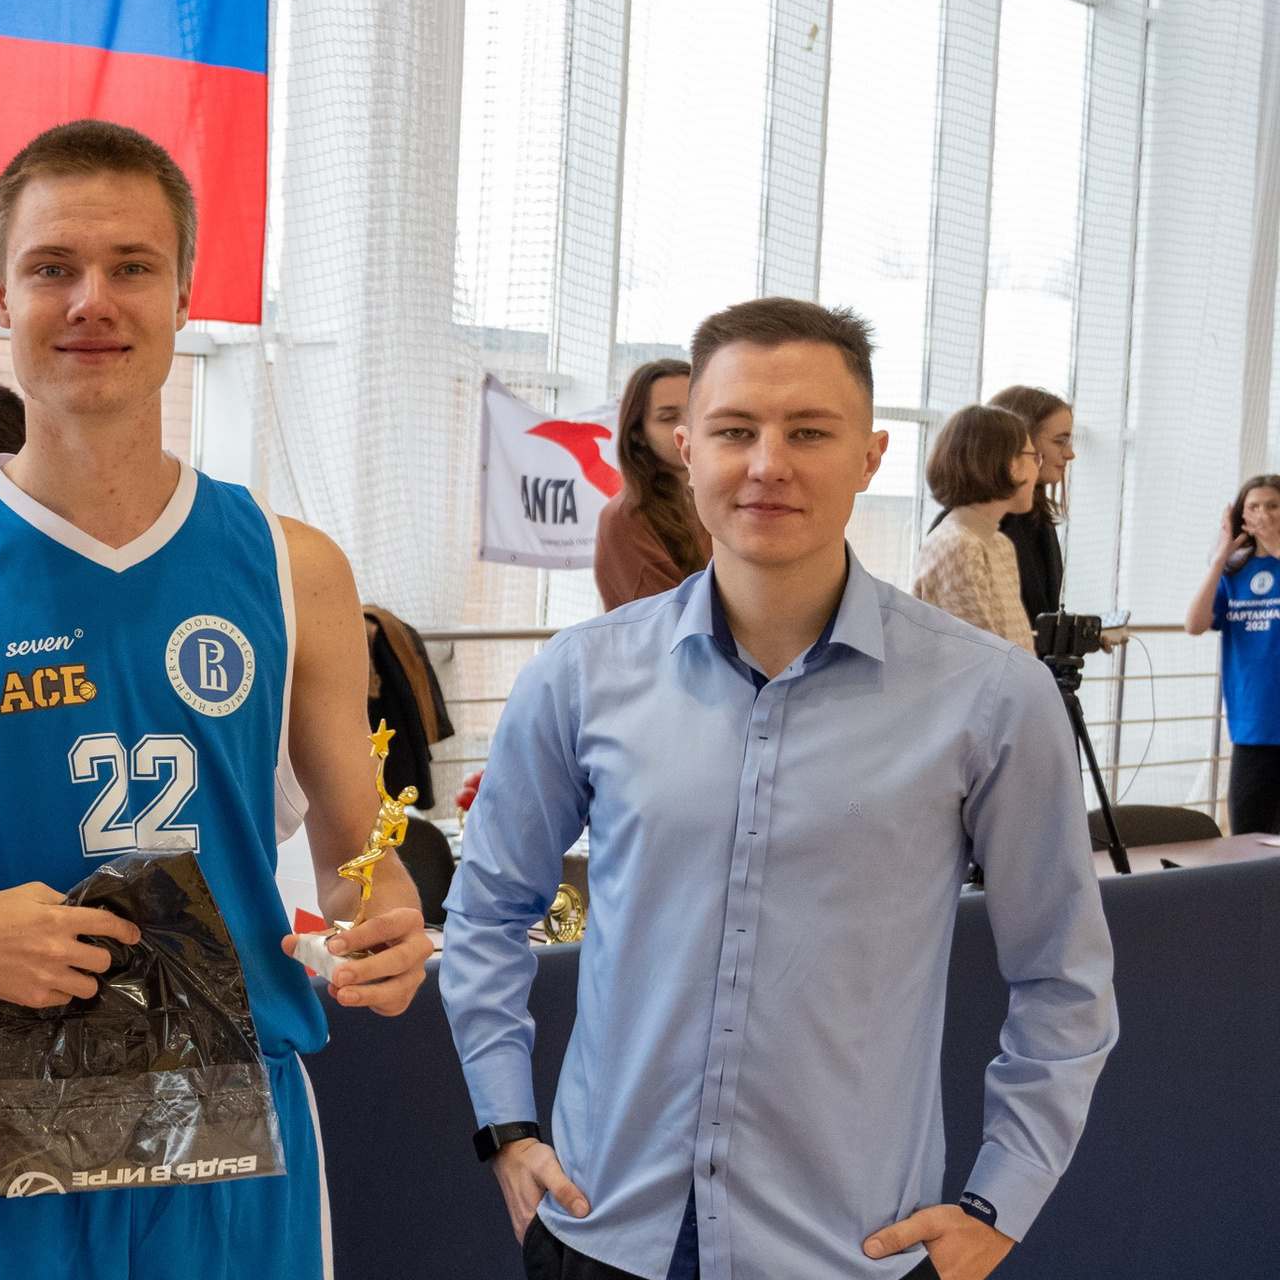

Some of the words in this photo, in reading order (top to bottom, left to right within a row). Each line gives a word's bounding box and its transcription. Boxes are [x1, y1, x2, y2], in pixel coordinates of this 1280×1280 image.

[168, 617, 211, 654] SCHOOL
[219, 621, 236, 635] OF
[168, 663, 207, 712] HIGHER
[218, 641, 253, 715] ECONOMICS
[67, 732, 201, 858] 22
[71, 1167, 146, 1187] ИГРЕ
[150, 1164, 173, 1182] В
[175, 1155, 258, 1180] БУДЬ
